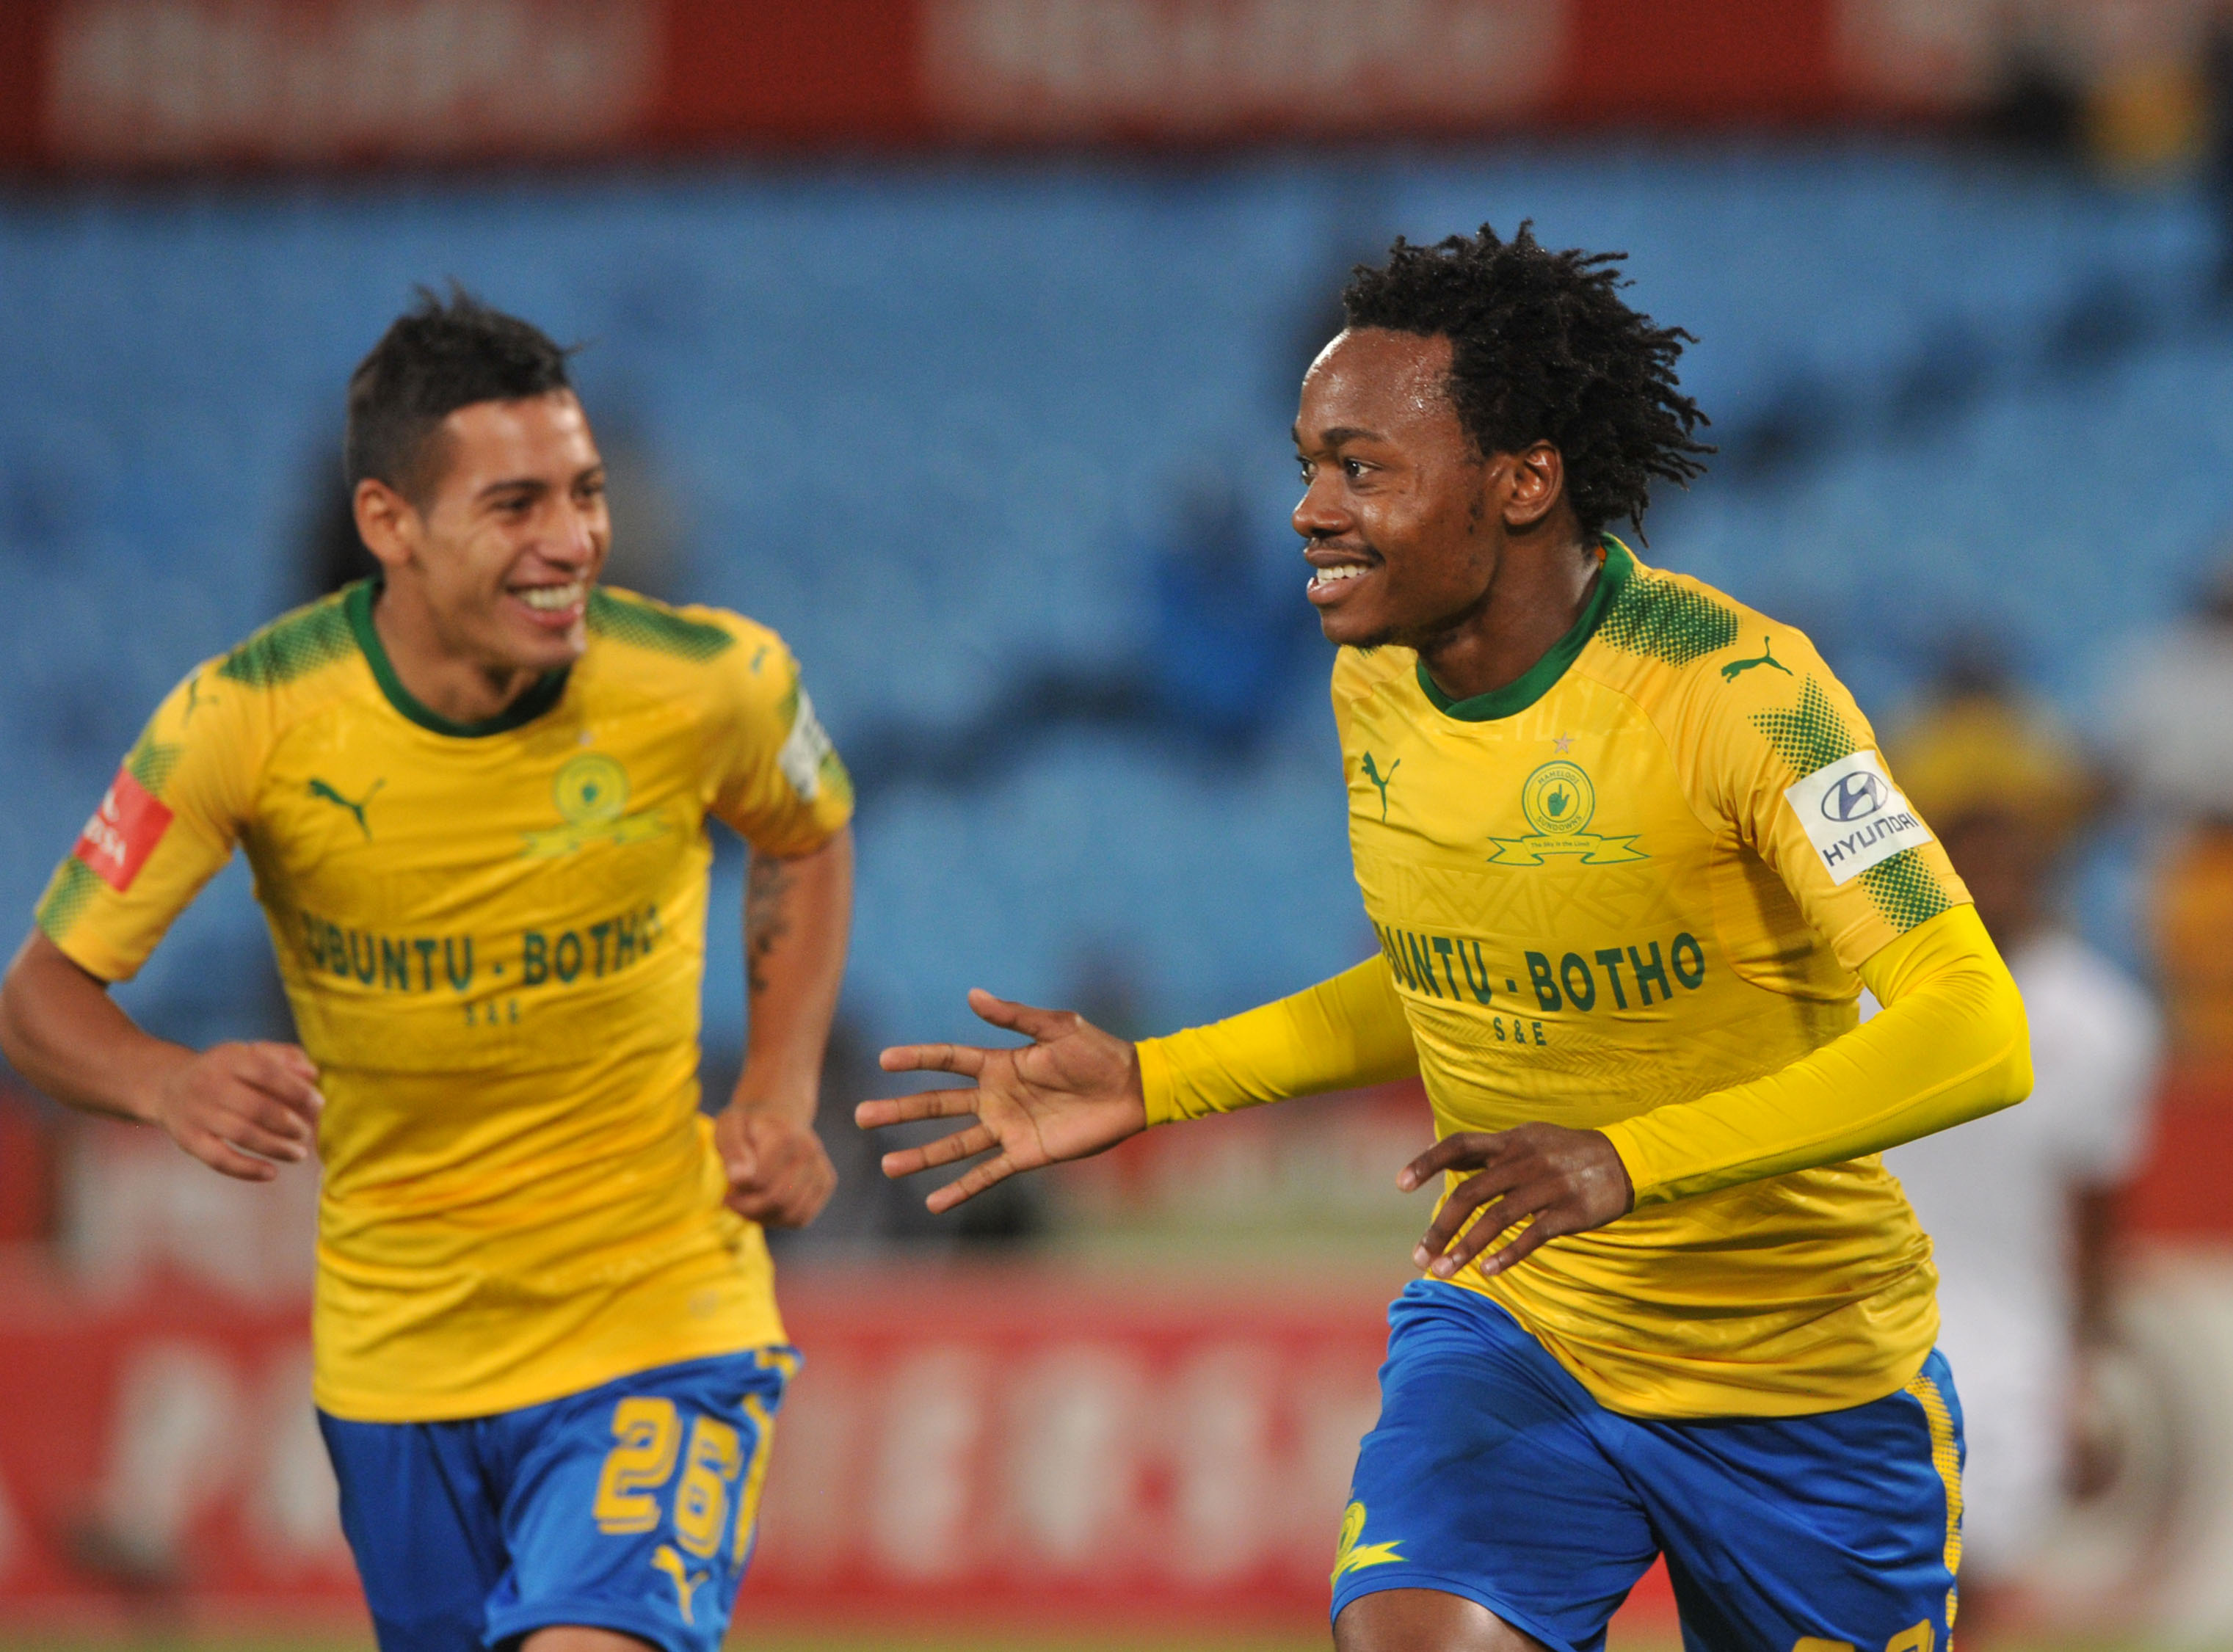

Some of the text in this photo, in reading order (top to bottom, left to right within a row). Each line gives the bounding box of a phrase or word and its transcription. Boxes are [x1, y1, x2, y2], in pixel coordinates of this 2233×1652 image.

[1537, 770, 1580, 785] MAMELODI
[1536, 815, 1583, 832] SUNDOWNS
[1822, 812, 1919, 867] HYUNDAI
[1524, 932, 1705, 1012] BOTHO
[1493, 1016, 1547, 1046] S & E
[592, 1396, 743, 1560] 26
